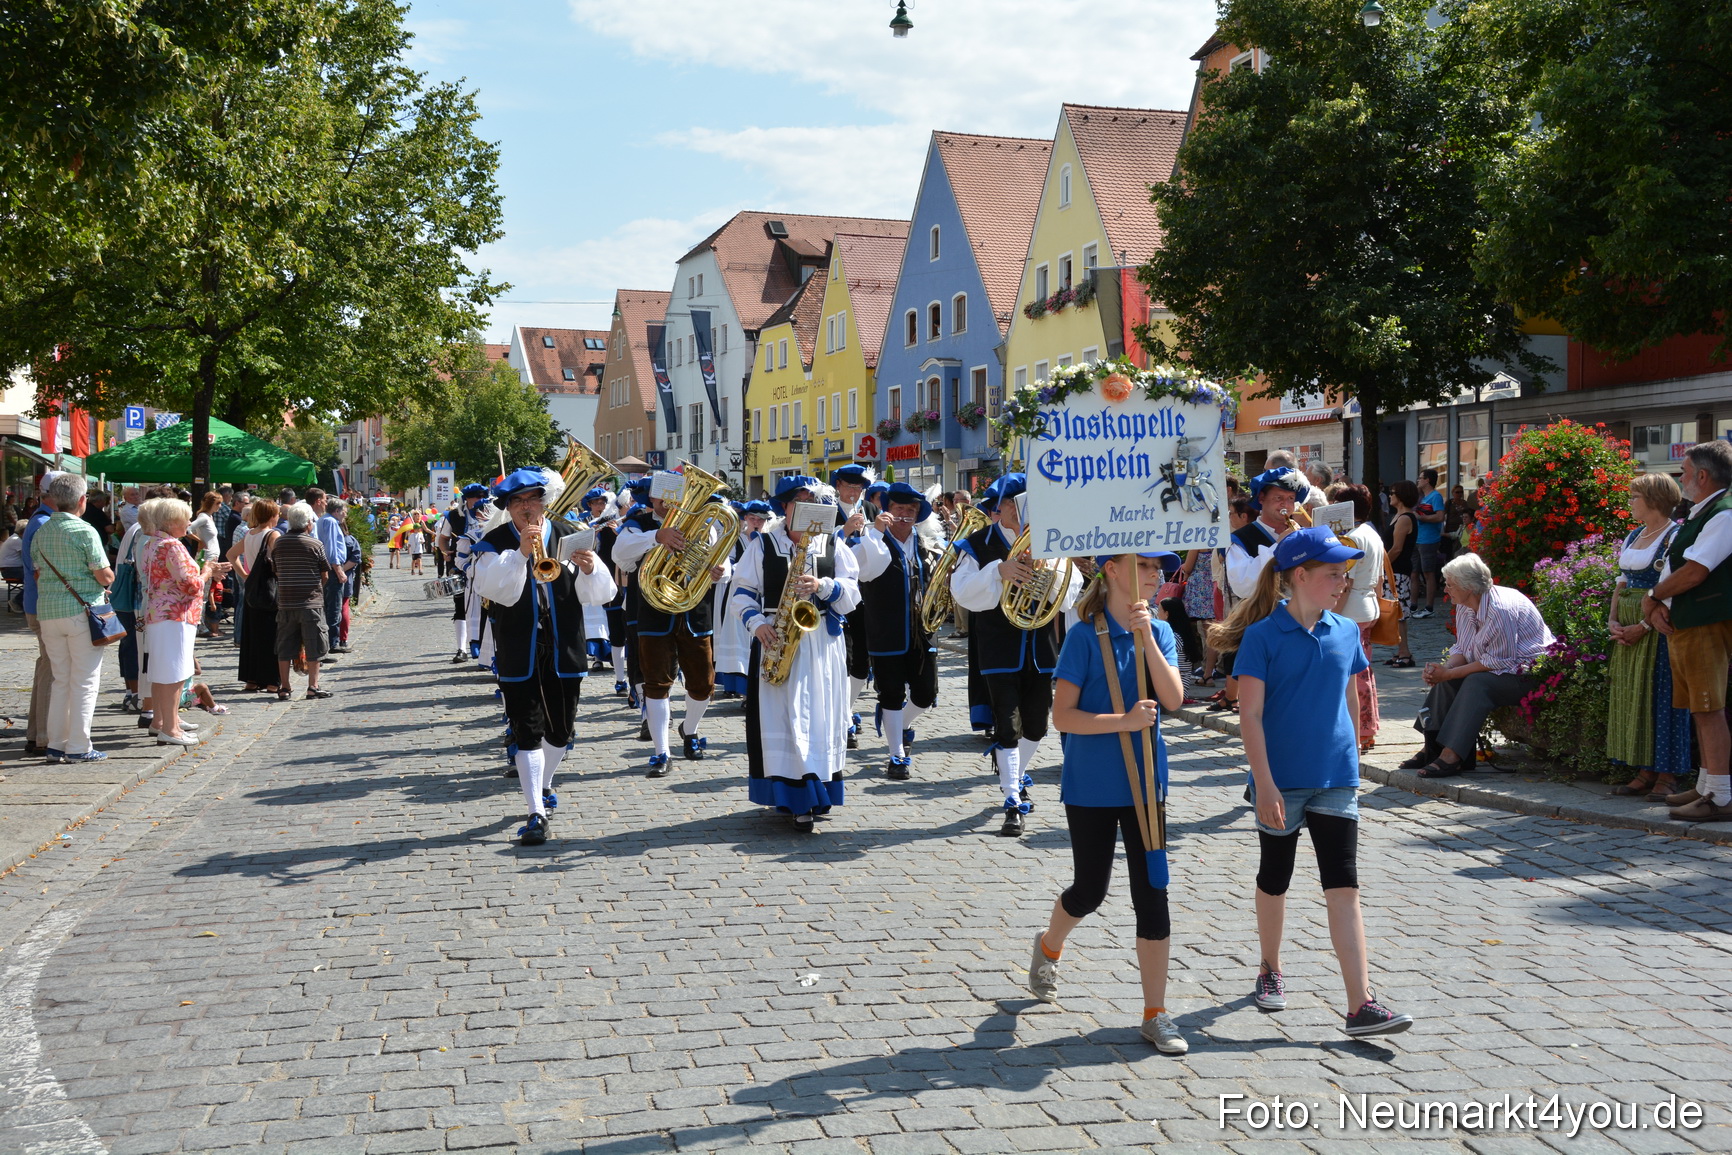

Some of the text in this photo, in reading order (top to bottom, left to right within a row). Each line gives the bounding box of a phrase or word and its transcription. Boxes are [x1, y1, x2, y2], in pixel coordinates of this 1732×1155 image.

[772, 386, 788, 400] HOTEL
[129, 409, 140, 426] P
[1034, 405, 1186, 443] Blaskapelle
[1036, 446, 1151, 489] Eppelein
[1109, 505, 1156, 523] Markt
[1043, 521, 1220, 552] Postbauer-Heng
